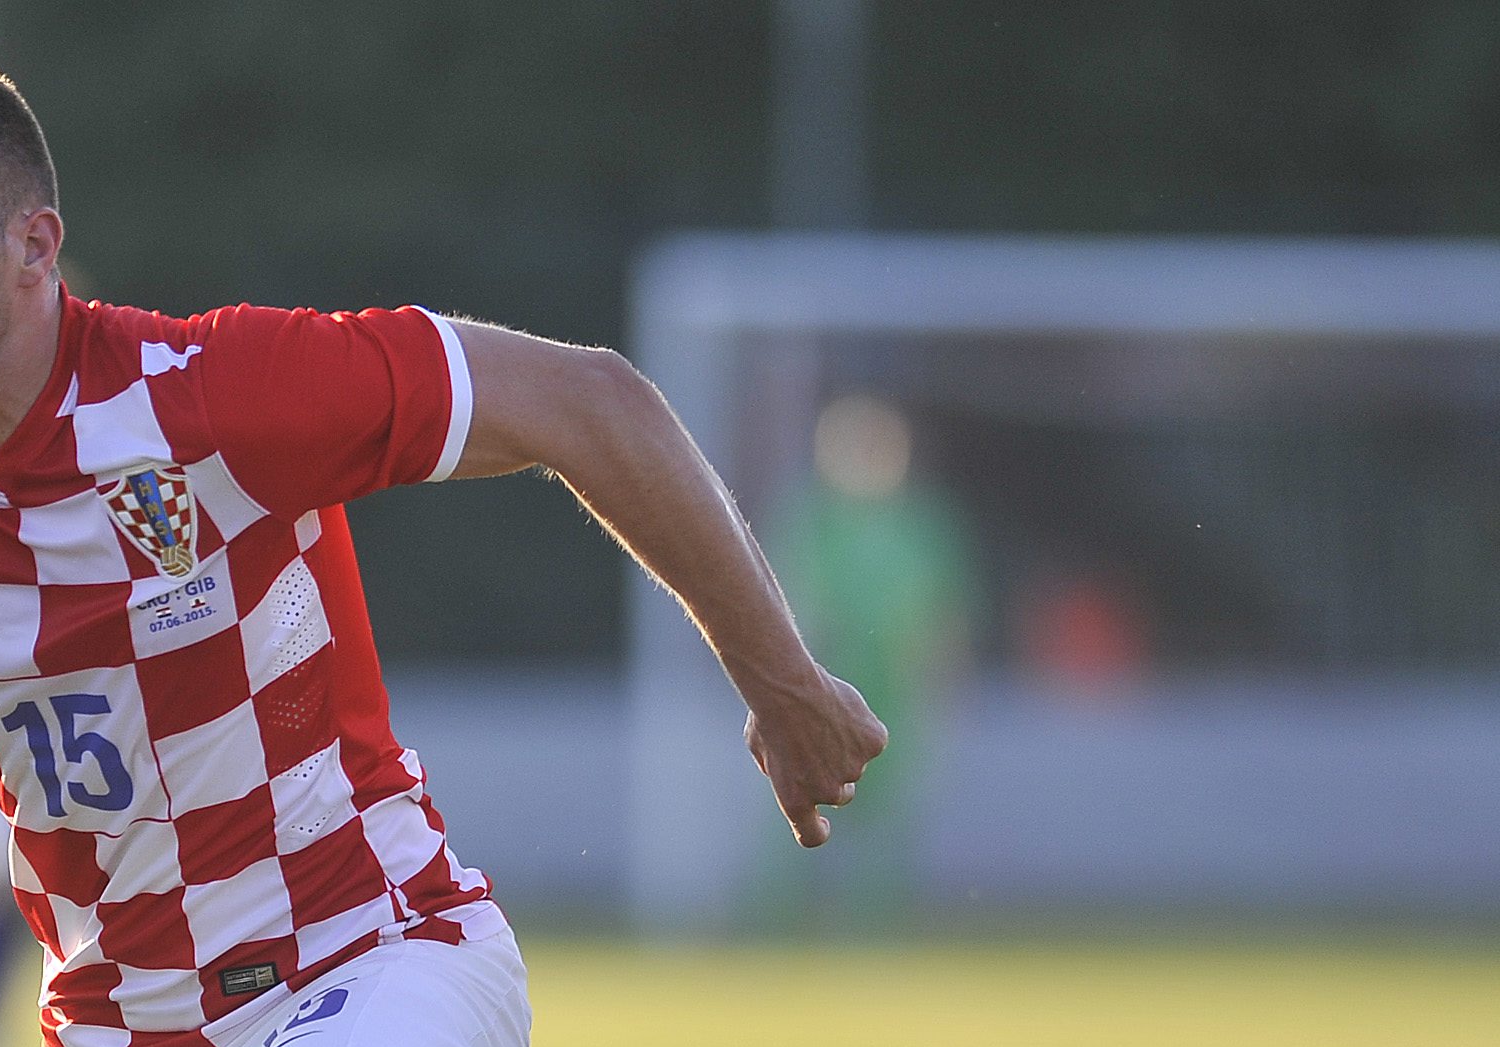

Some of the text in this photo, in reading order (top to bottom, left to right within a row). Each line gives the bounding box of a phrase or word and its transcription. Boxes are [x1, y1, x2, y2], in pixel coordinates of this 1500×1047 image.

[185, 577, 216, 596] GIB
[149, 606, 217, 633] 07.06.2015.
[1, 693, 134, 818] 15
